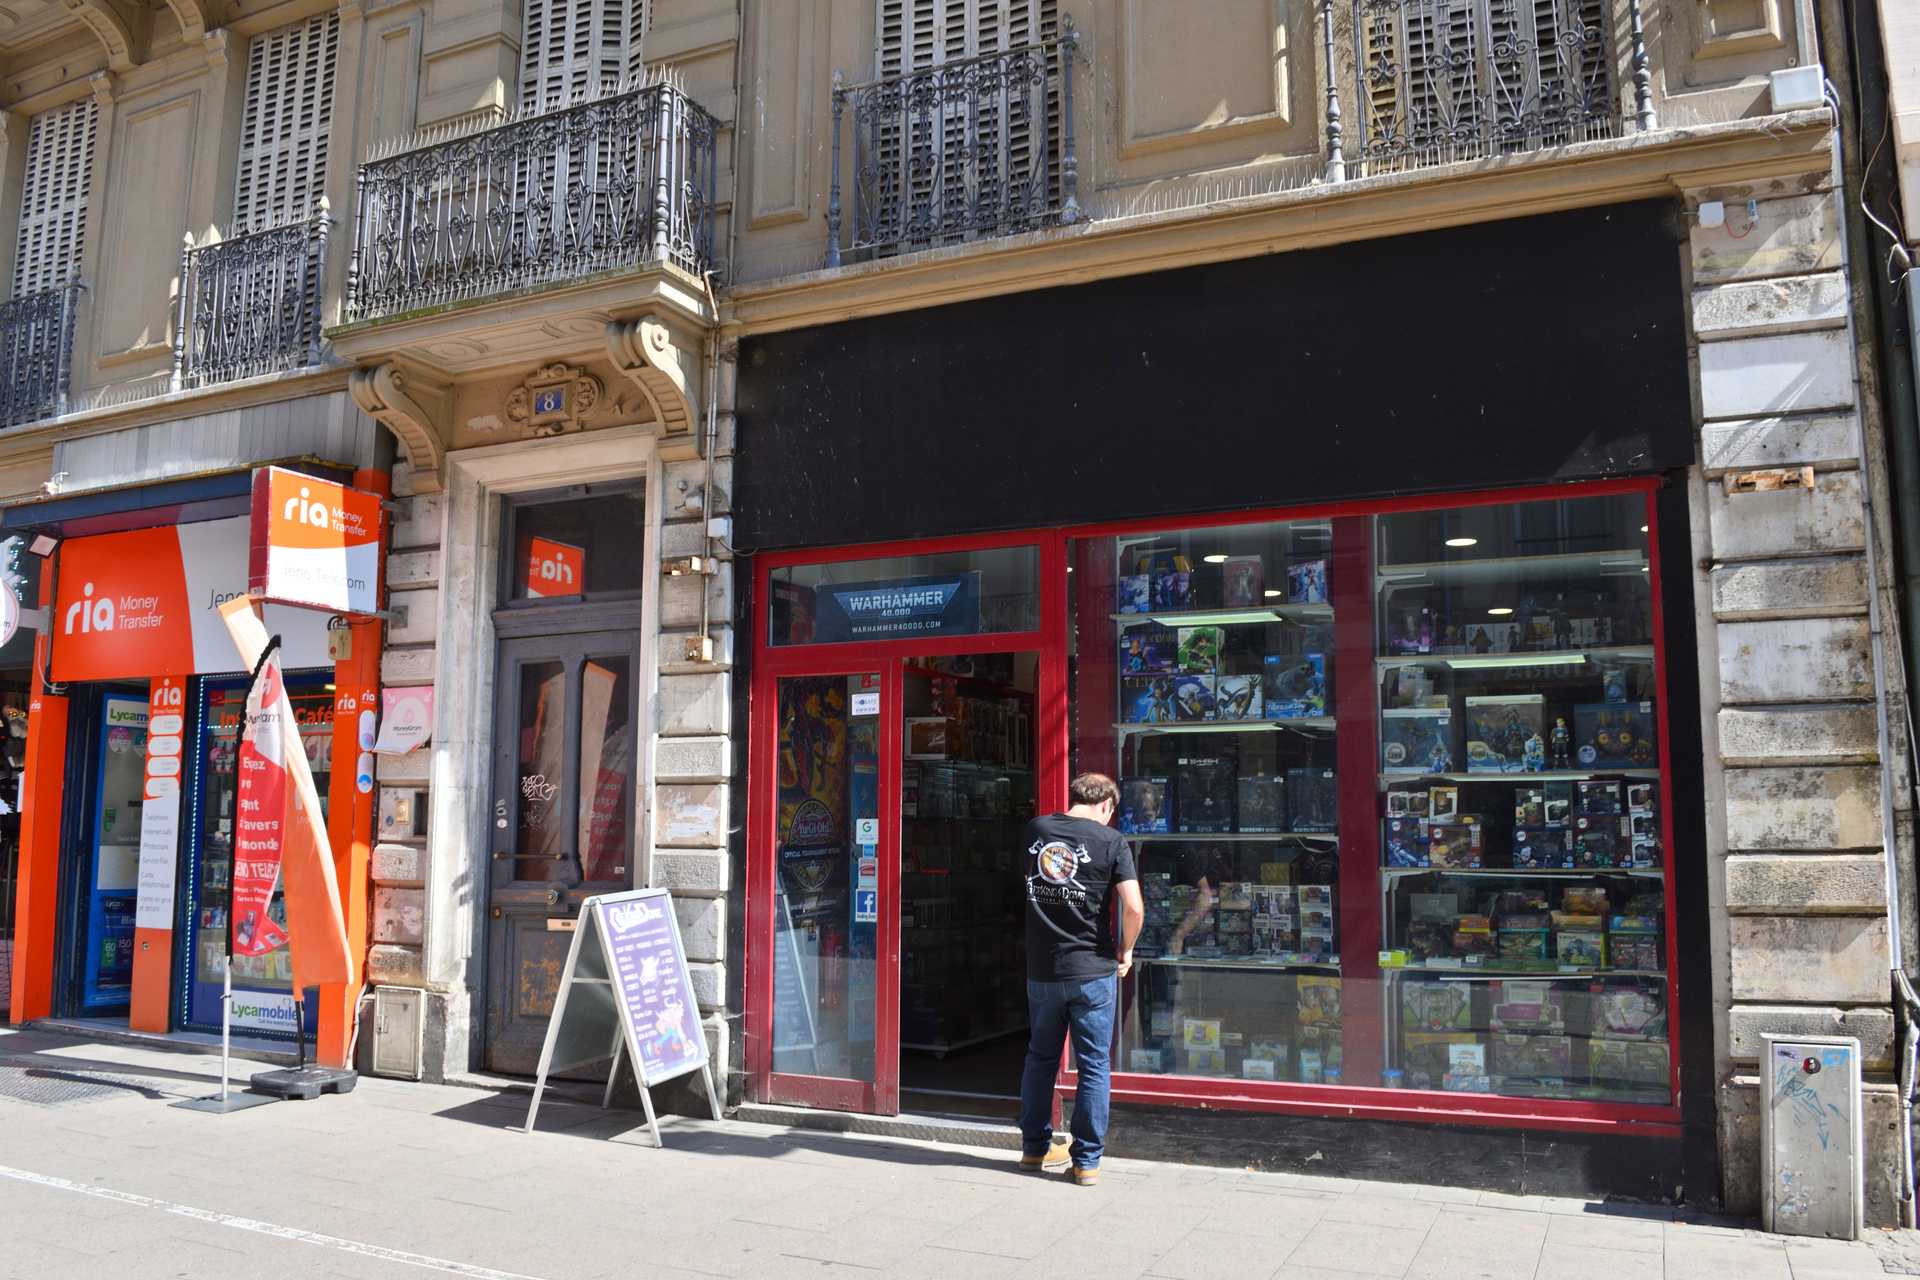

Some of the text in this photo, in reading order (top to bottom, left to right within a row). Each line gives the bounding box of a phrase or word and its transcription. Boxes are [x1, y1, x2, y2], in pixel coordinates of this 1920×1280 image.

[544, 392, 554, 411] 8
[284, 487, 328, 529] ria
[332, 506, 362, 523] Money
[332, 518, 368, 537] Transfer
[65, 582, 115, 635] ria
[120, 595, 159, 612] Money
[850, 591, 943, 611] WARHAMMER
[119, 612, 165, 630] Transfer
[852, 621, 941, 633] WARHAMMER40000.COM
[153, 678, 181, 707] ria
[337, 692, 356, 710] ria
[362, 689, 375, 702] ria
[110, 708, 149, 721] Lycam
[295, 705, 334, 725] Café
[232, 1001, 297, 1020] Lycamobile
